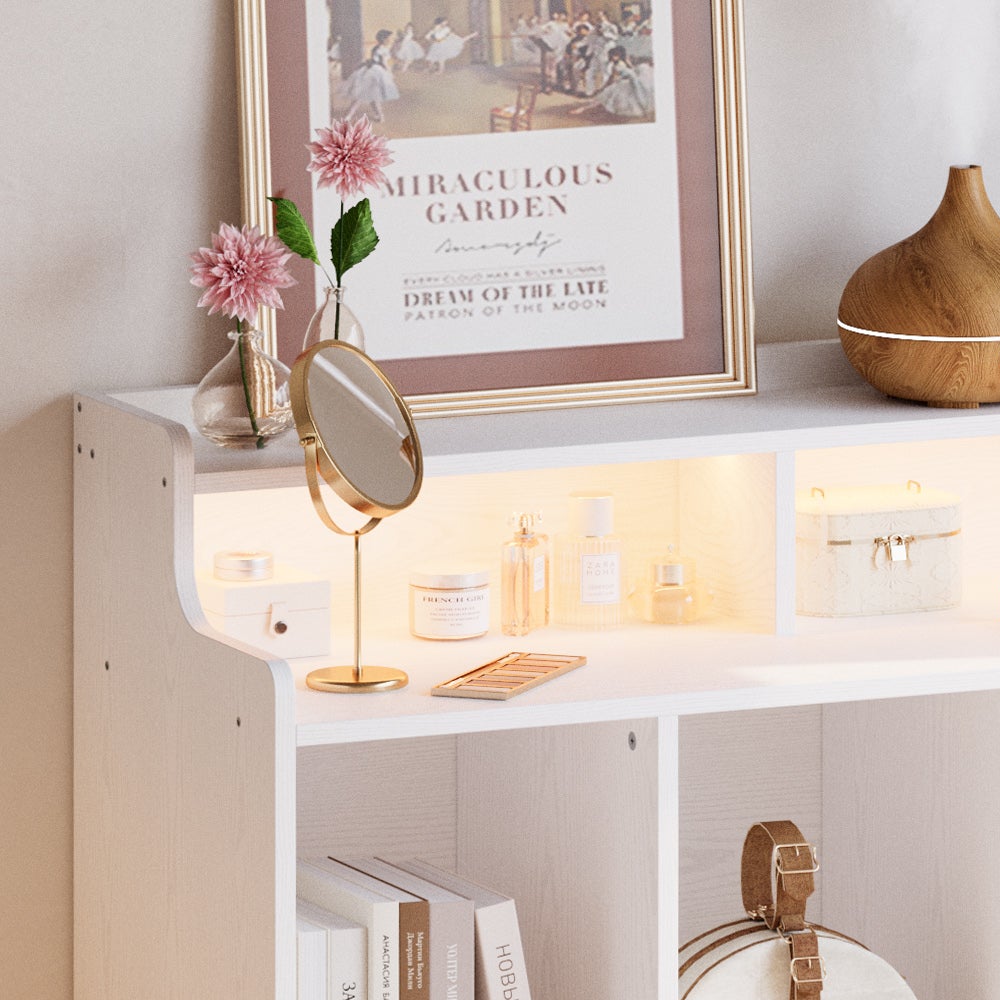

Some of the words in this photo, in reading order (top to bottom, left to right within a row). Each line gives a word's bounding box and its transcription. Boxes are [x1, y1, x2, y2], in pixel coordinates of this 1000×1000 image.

[382, 162, 613, 199] MIRACULOUS
[426, 194, 567, 224] GARDEN
[404, 289, 473, 308] DREAM
[482, 286, 512, 302] OF
[518, 282, 557, 300] THE
[563, 278, 609, 297] LATE
[404, 307, 473, 321] PATRON
[482, 305, 503, 317] OF
[514, 302, 542, 314] THE
[553, 298, 606, 312] MOON
[382, 934, 391, 989] АНАСТАСИЯ
